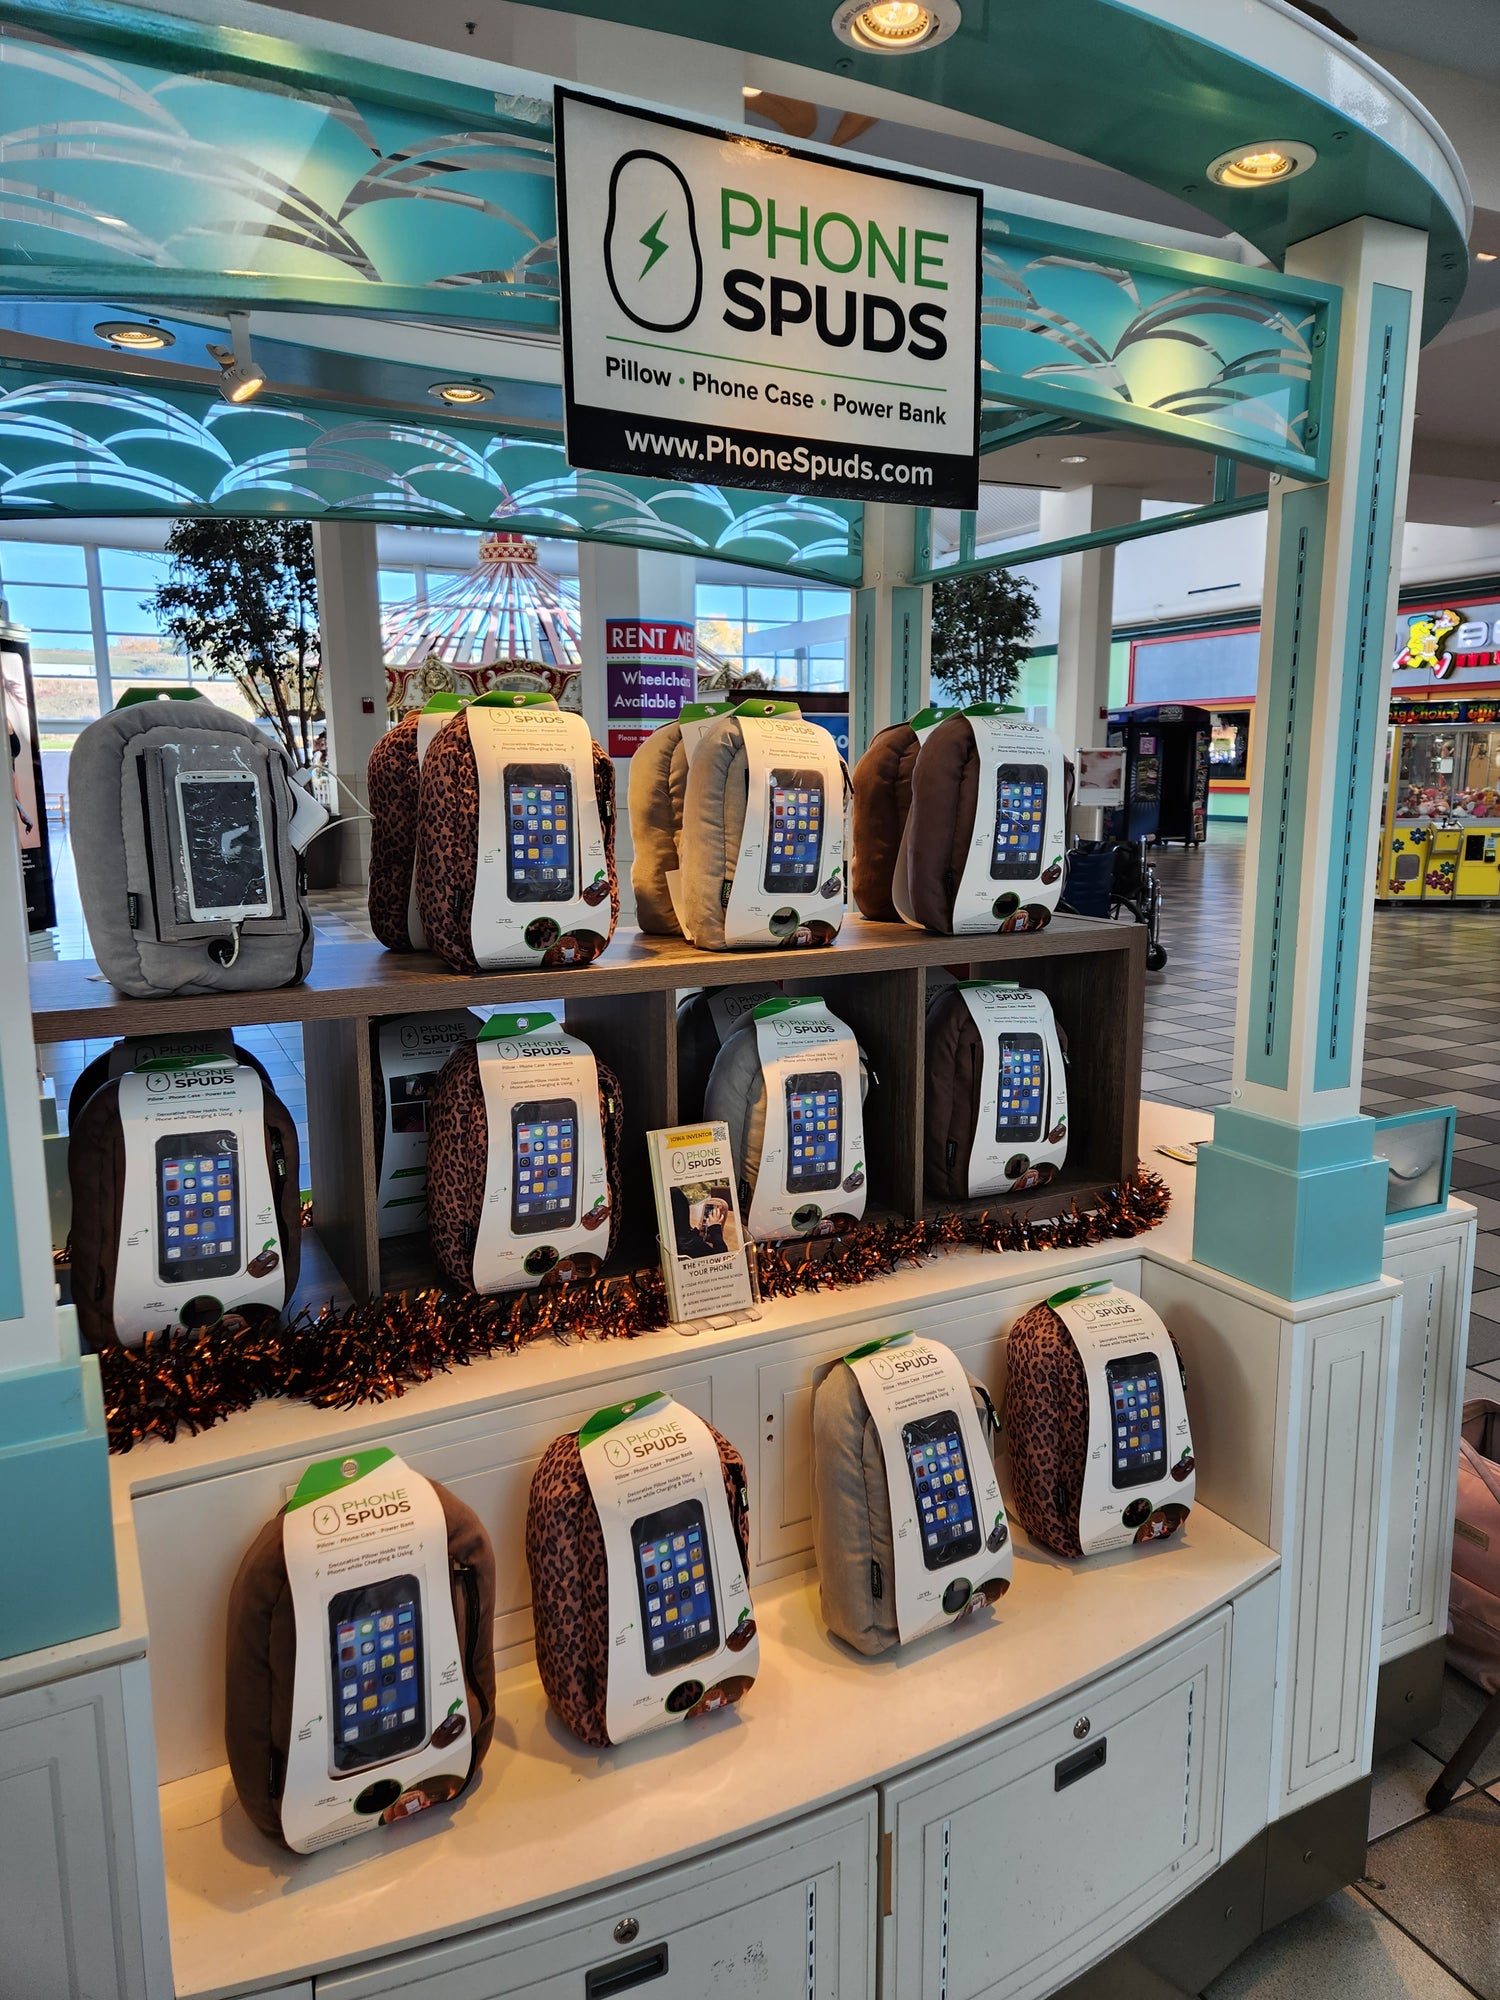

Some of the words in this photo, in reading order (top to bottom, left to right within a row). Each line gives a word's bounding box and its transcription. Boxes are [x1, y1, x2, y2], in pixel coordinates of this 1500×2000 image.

[721, 187, 949, 290] PHONE
[722, 268, 947, 360] SPUDS
[606, 356, 671, 386] Pillow
[693, 372, 758, 400] Phone
[765, 383, 814, 408] Case
[834, 394, 892, 419] Power
[900, 402, 946, 424] Bank
[625, 429, 933, 485] www.PhoneSpuds.com
[612, 627, 667, 649] RENT
[613, 694, 677, 709] Available
[996, 993, 1032, 1001] SPUDS
[420, 1023, 465, 1033] PHONE
[794, 1025, 835, 1034] SPUDS
[423, 1032, 468, 1044] SPUDS
[160, 1044, 213, 1055] PHONE
[522, 1047, 571, 1057] SPUDS
[173, 1068, 233, 1079] PHONE
[175, 1075, 235, 1088] SPUDS
[687, 1148, 720, 1160] PHONE
[688, 1157, 721, 1169] SPUDS
[689, 1268, 707, 1277] YOUR
[710, 1263, 733, 1273] PHONE
[1088, 1298, 1128, 1309] PHONE
[1096, 1305, 1135, 1318] SPUDS
[886, 1346, 931, 1362] PHONE
[895, 1354, 938, 1372] SPUDS
[626, 1421, 681, 1446] PHONE
[633, 1432, 687, 1458] SPUDS
[634, 1466, 649, 1474] Phone
[342, 1488, 408, 1512] PHONE
[346, 1501, 411, 1526] SPUDS
